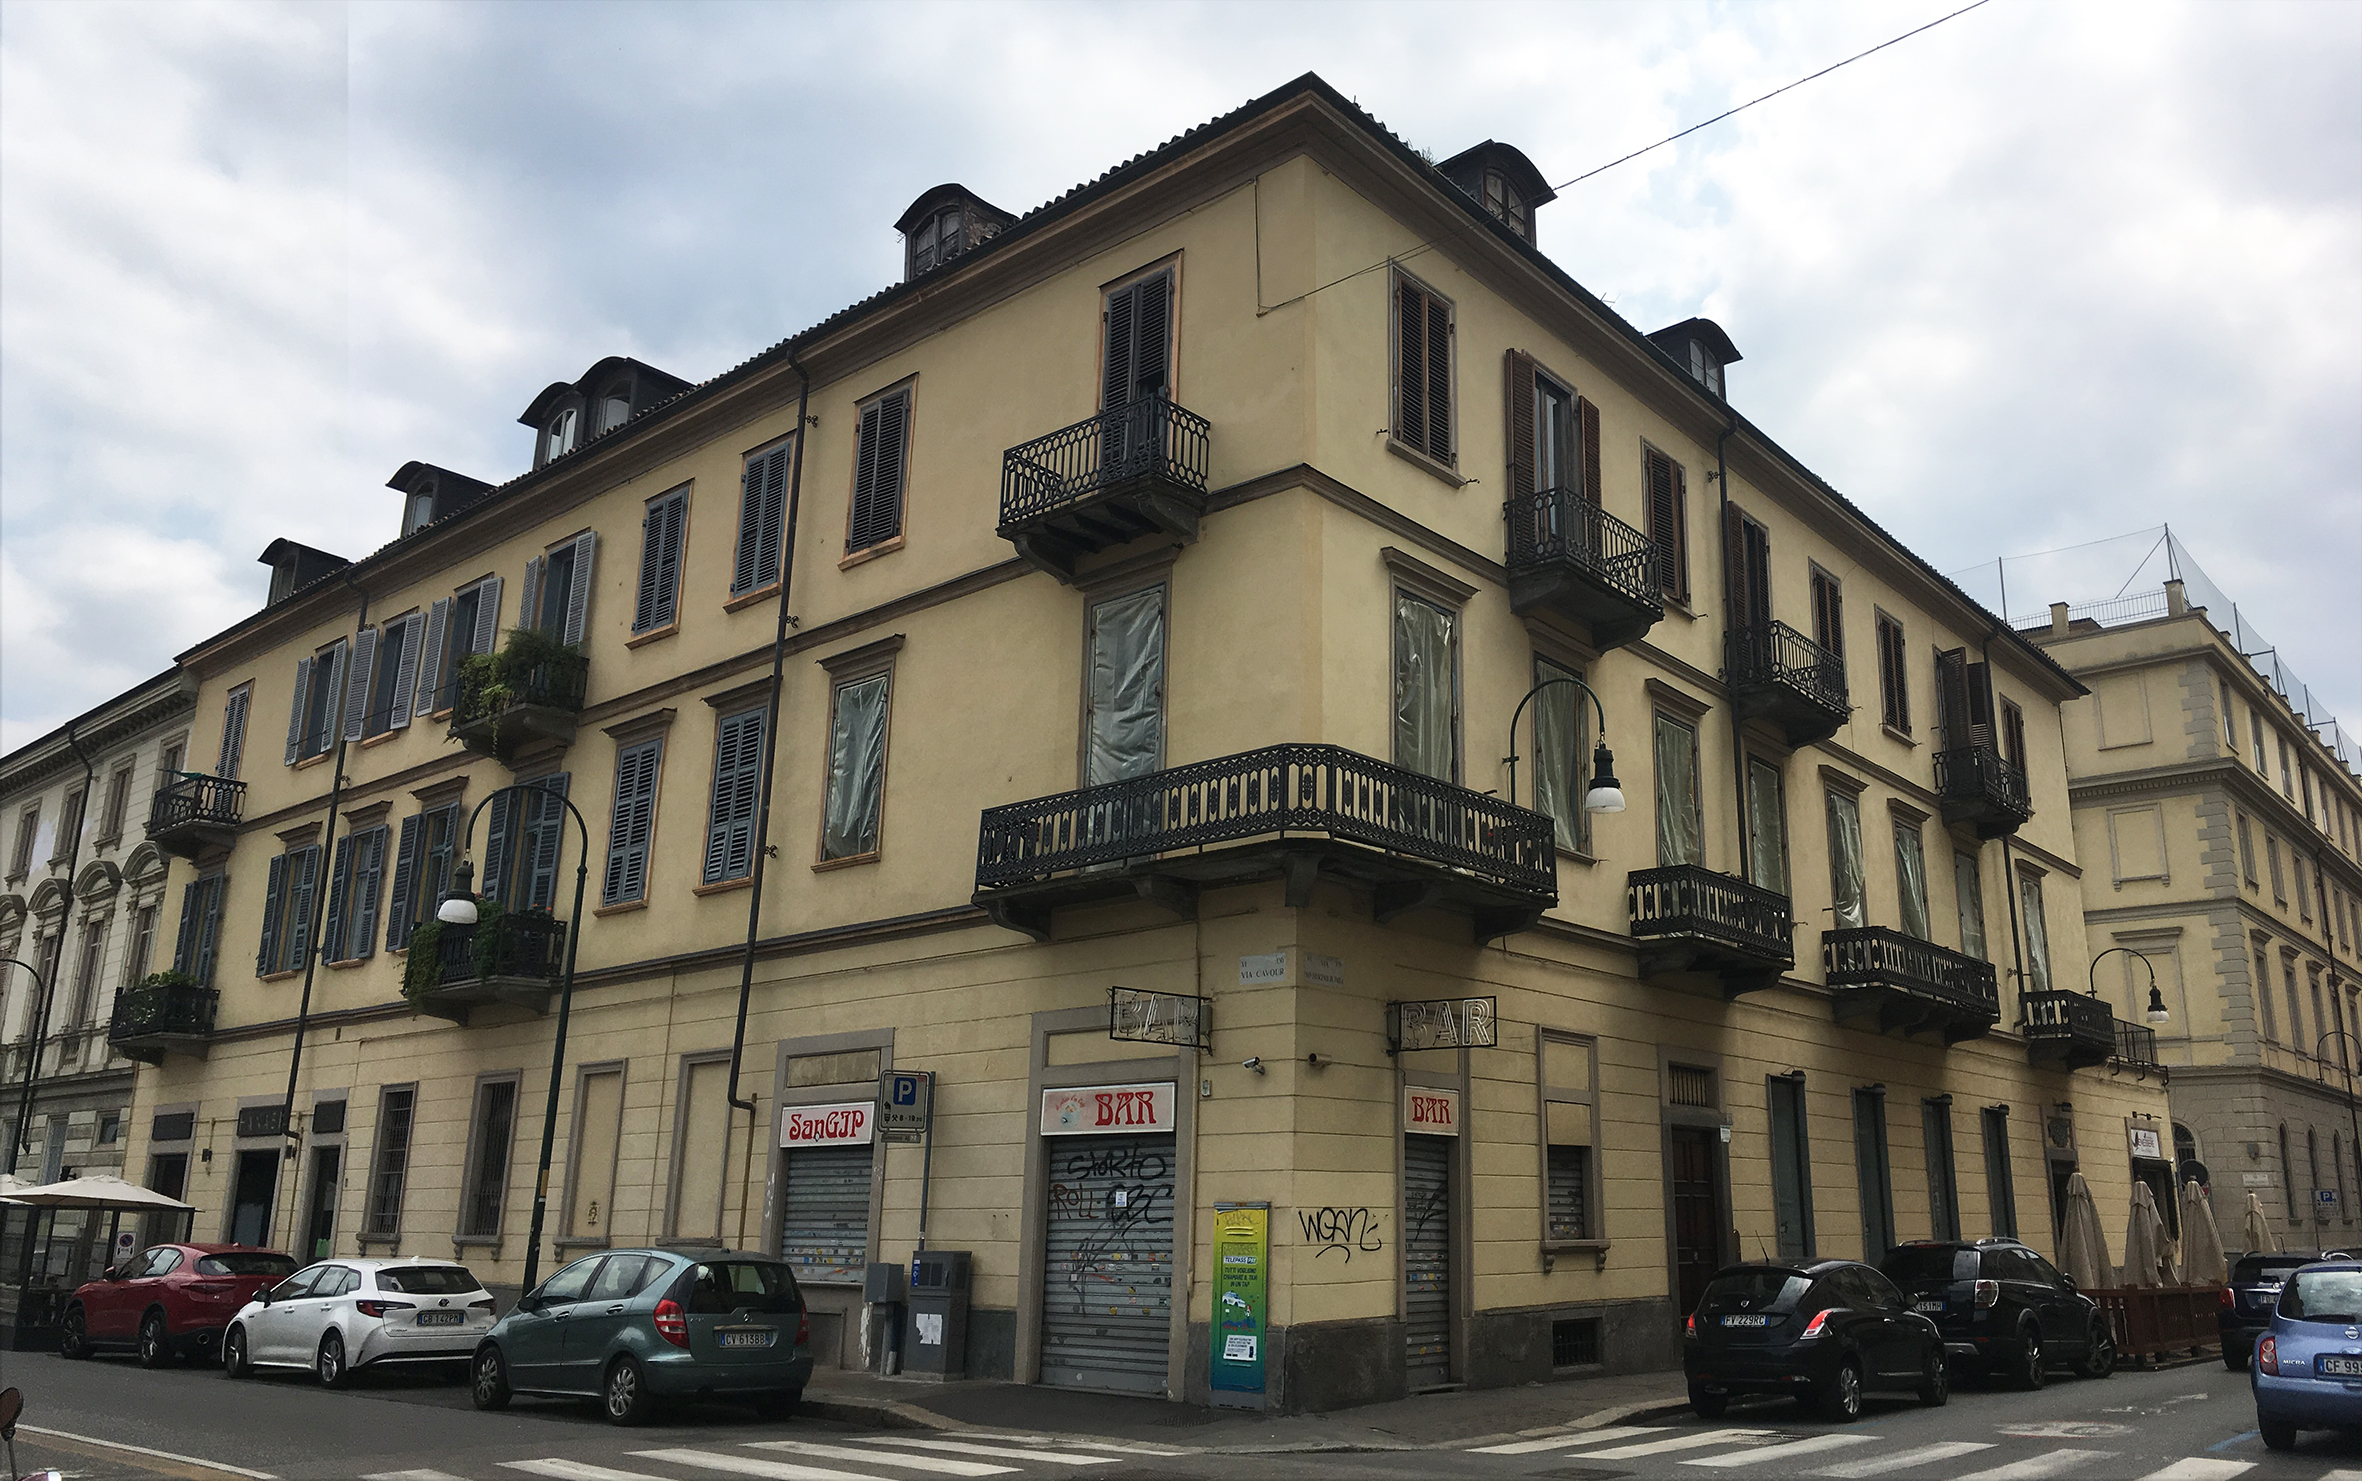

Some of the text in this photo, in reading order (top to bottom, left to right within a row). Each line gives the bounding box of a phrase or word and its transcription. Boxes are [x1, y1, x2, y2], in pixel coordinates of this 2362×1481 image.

[1401, 999, 1490, 1049] BAR
[898, 1080, 913, 1102] P
[1094, 1091, 1157, 1127] BAR
[1411, 1096, 1452, 1125] BAR
